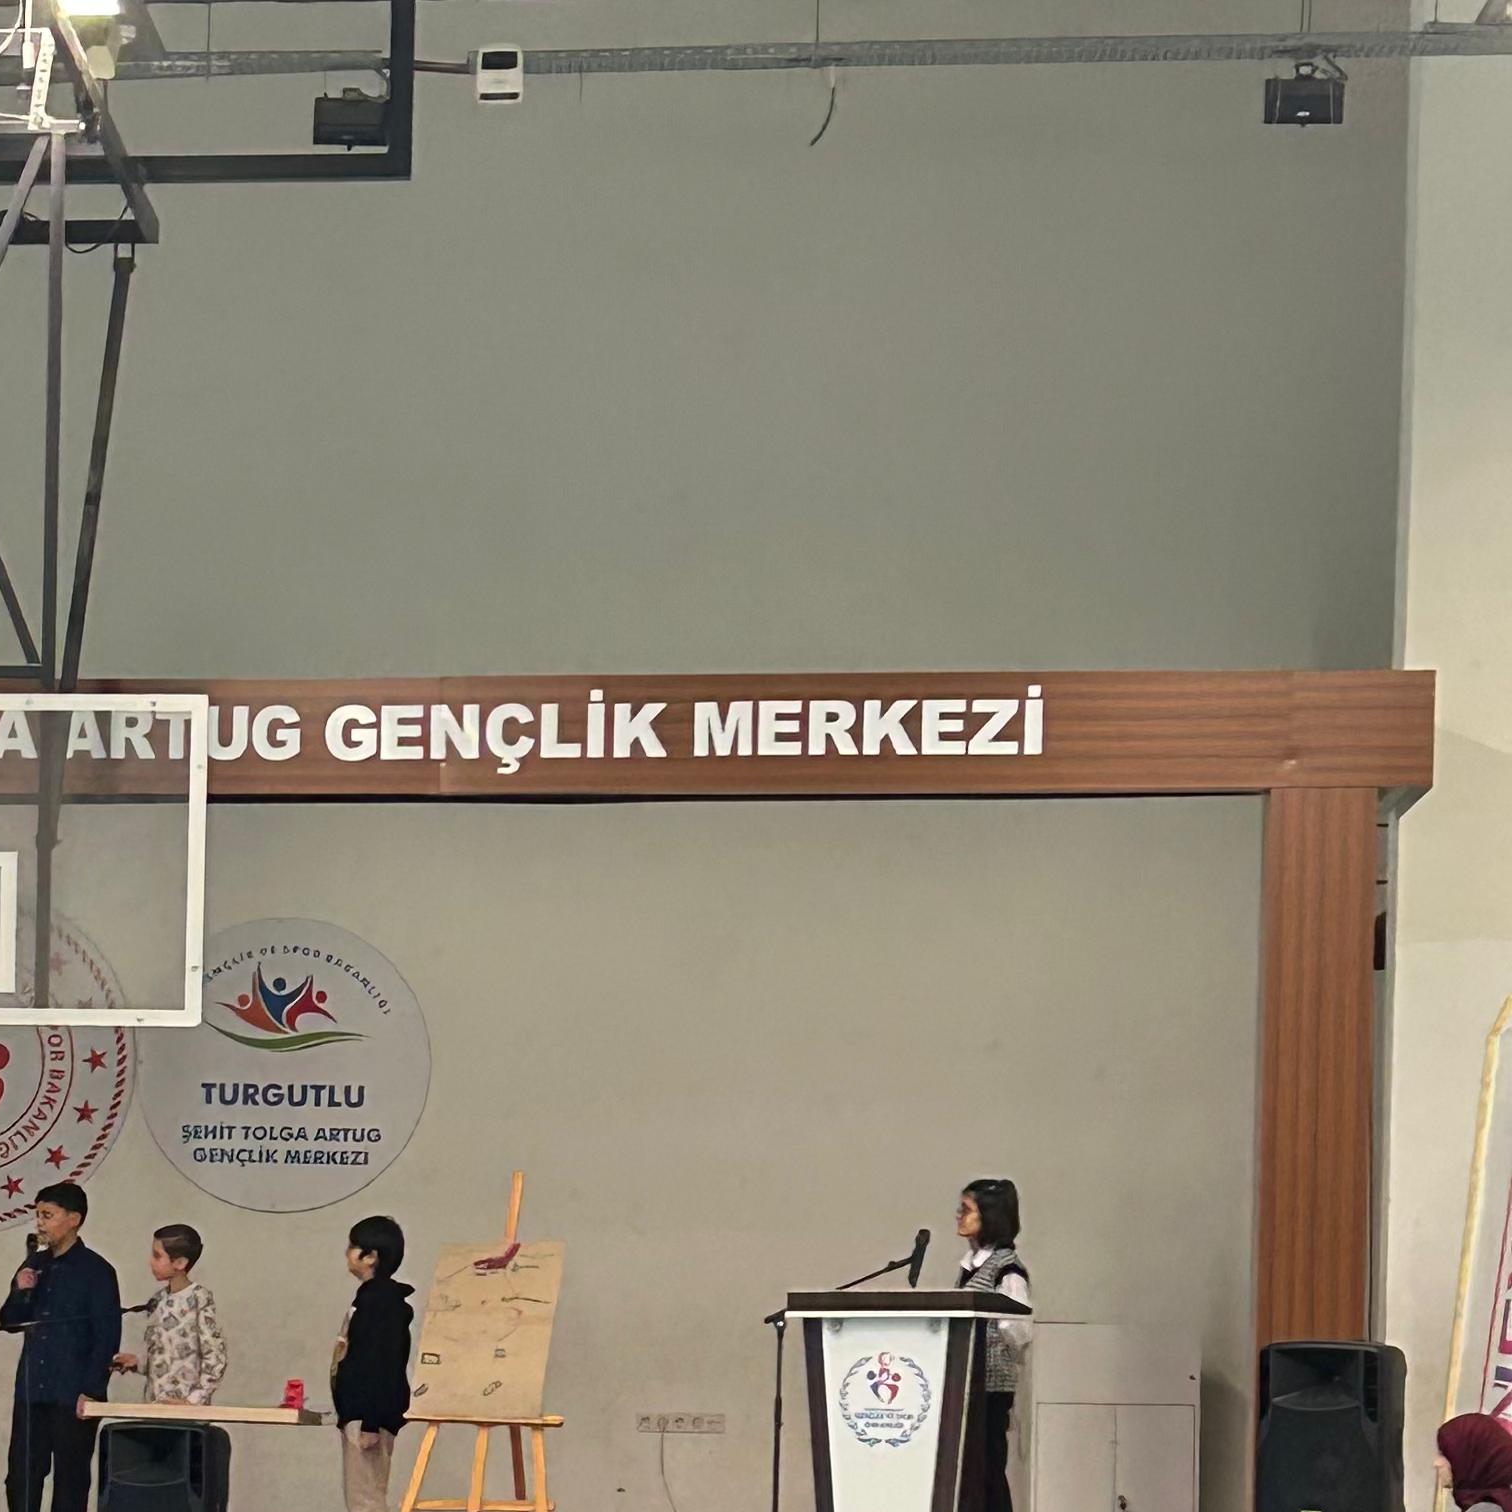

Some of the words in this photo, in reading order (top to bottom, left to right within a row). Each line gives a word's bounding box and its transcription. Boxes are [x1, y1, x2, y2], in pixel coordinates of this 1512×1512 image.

[65, 704, 302, 760] ARTUG
[324, 688, 668, 774] GENÇLİK
[692, 684, 1043, 757] MERKEZİ
[201, 1082, 366, 1109] TURGUTLU
[181, 1121, 236, 1144] ŞEHİT
[241, 1125, 309, 1142] TOLGA
[313, 1127, 383, 1143] ARTUG
[192, 1144, 278, 1168] GENÇLİK
